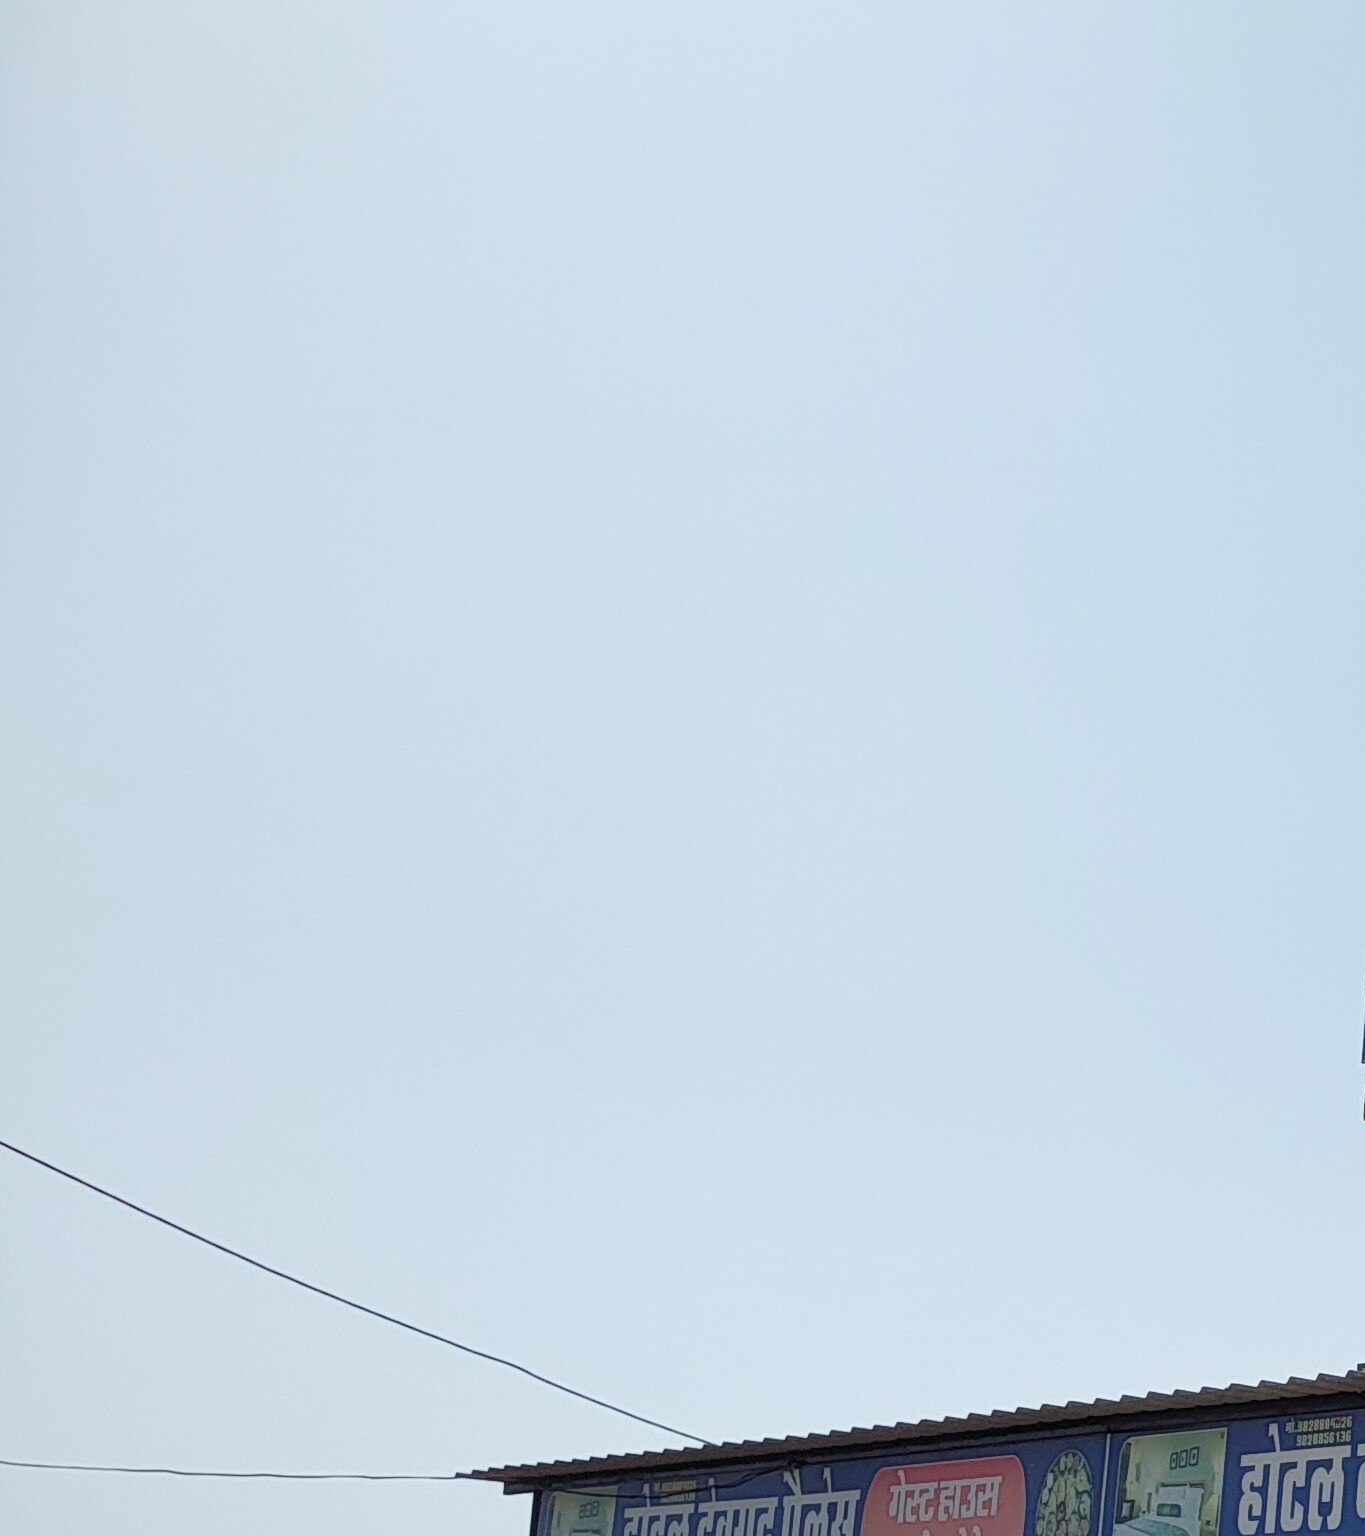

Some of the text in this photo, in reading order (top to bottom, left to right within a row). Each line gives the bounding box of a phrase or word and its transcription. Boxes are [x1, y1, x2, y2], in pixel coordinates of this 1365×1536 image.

[889, 1470, 1002, 1523] गेस्ट हाउस
[1238, 1423, 1352, 1535] होटल
